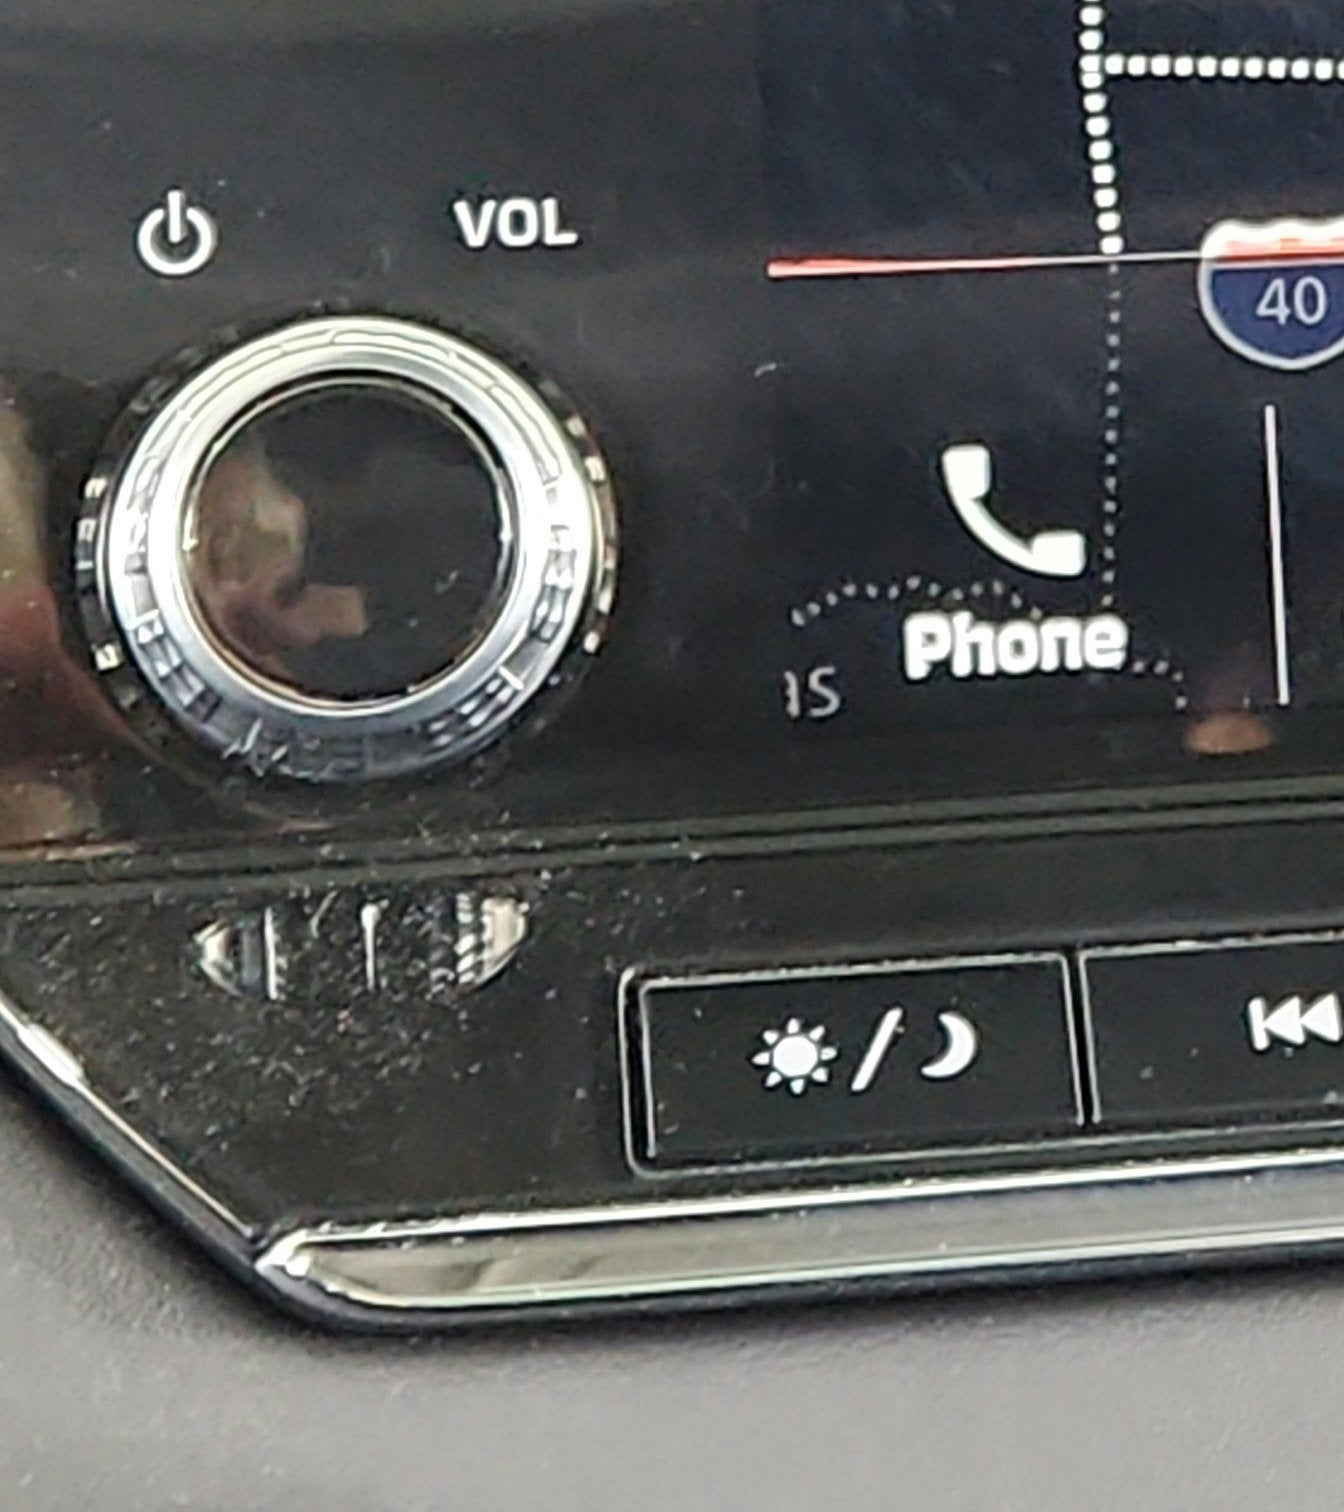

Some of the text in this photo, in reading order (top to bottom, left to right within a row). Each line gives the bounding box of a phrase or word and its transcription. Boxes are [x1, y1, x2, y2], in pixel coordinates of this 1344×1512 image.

[452, 197, 579, 249] VOL
[1255, 275, 1328, 326] 40
[903, 609, 1130, 681] Phone
